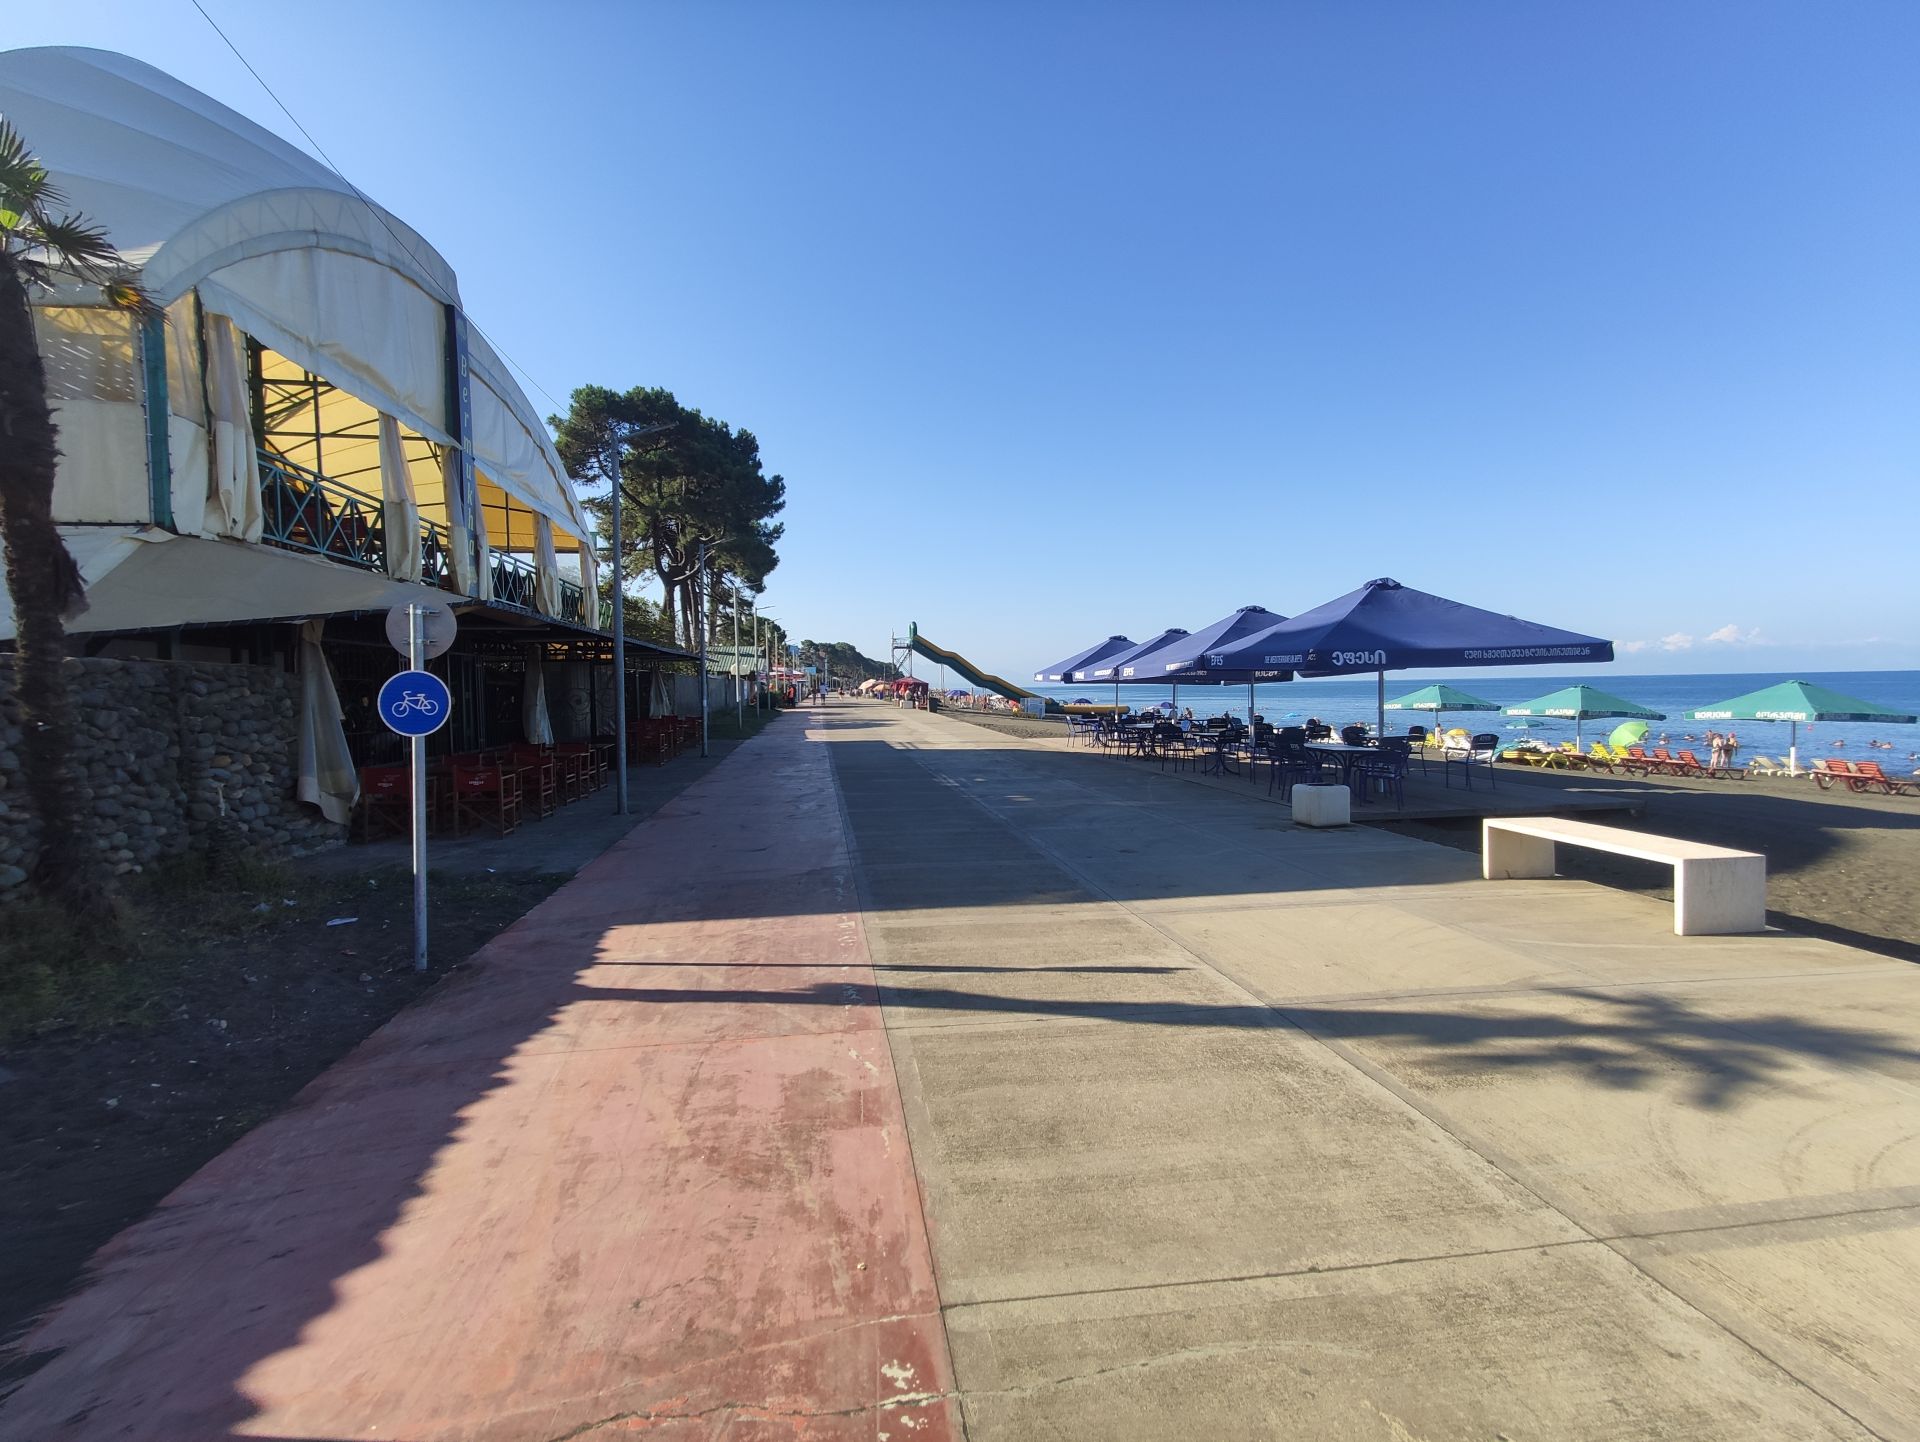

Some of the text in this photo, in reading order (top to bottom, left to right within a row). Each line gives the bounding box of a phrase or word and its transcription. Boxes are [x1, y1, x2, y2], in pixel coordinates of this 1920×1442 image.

[460, 355, 475, 556] Bermukha
[1332, 649, 1386, 666] ეფესი
[1694, 711, 1732, 719] BORJOMI
